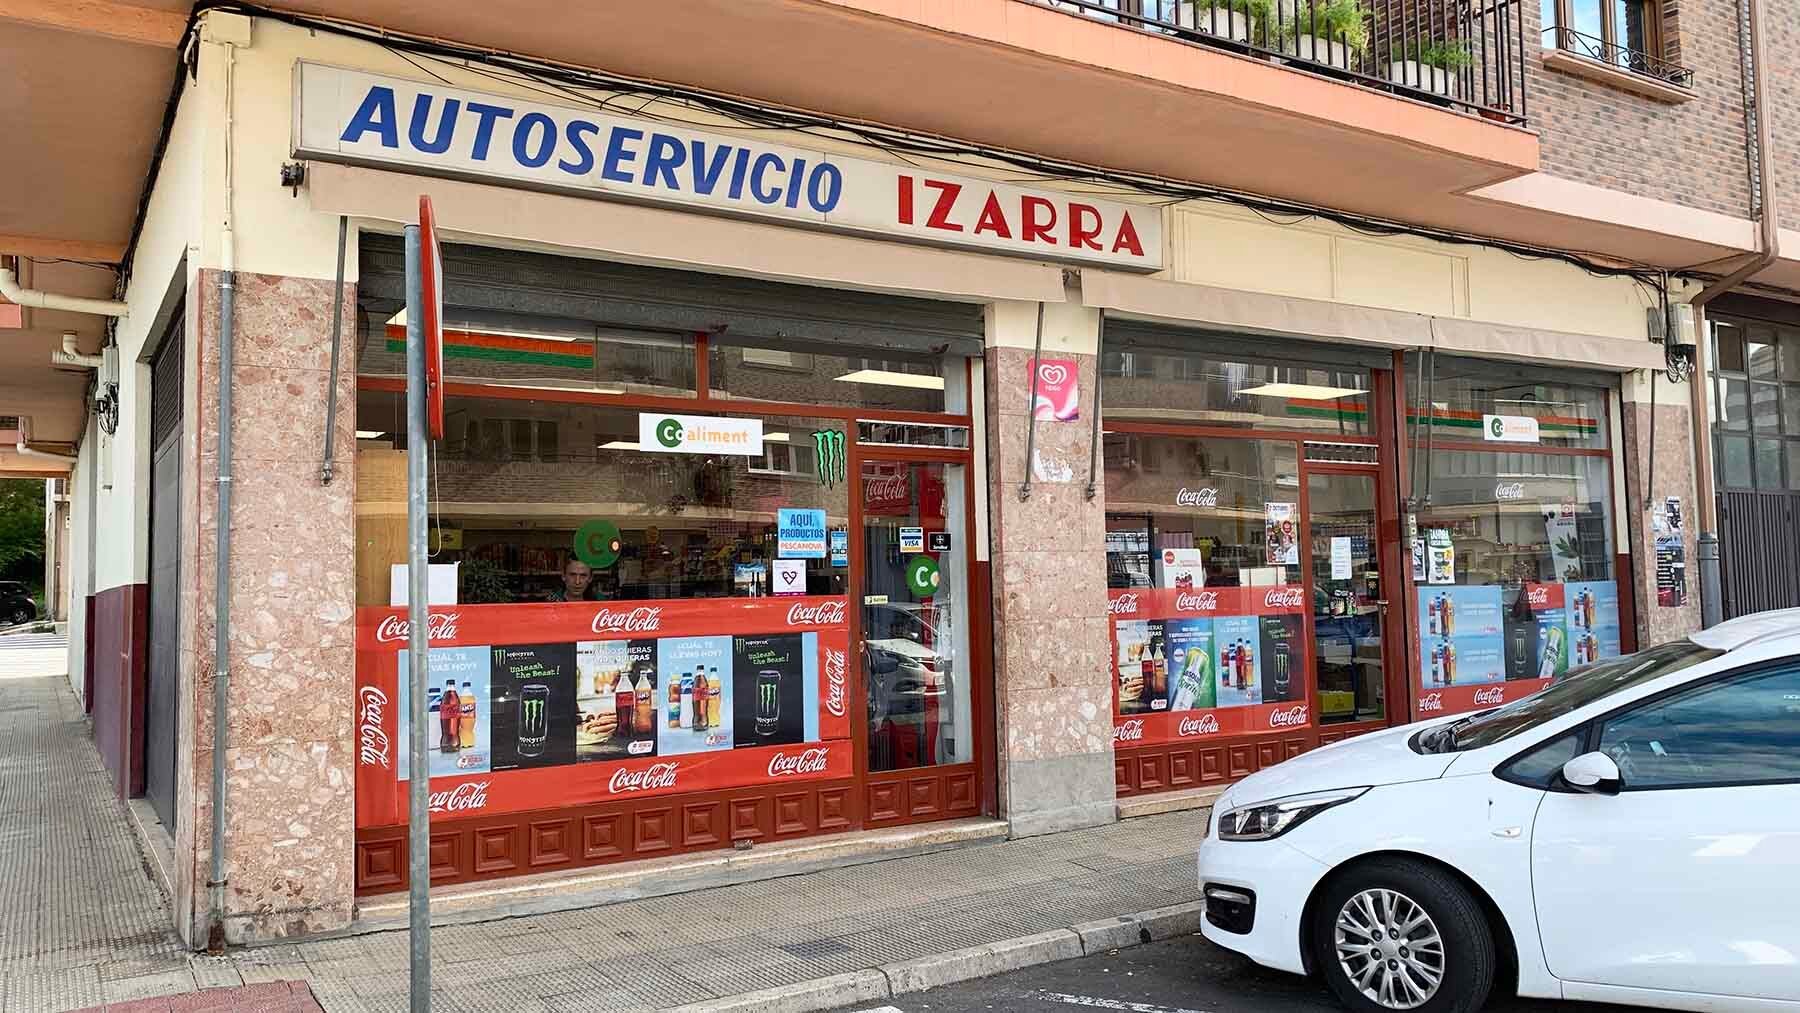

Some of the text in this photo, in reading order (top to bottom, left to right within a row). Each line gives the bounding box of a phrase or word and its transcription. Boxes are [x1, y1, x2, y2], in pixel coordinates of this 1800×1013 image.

[340, 86, 1145, 256] AUTOSERVICIO IZARRA
[780, 529, 824, 538] PRODUCTOS
[510, 663, 543, 674] Unleash
